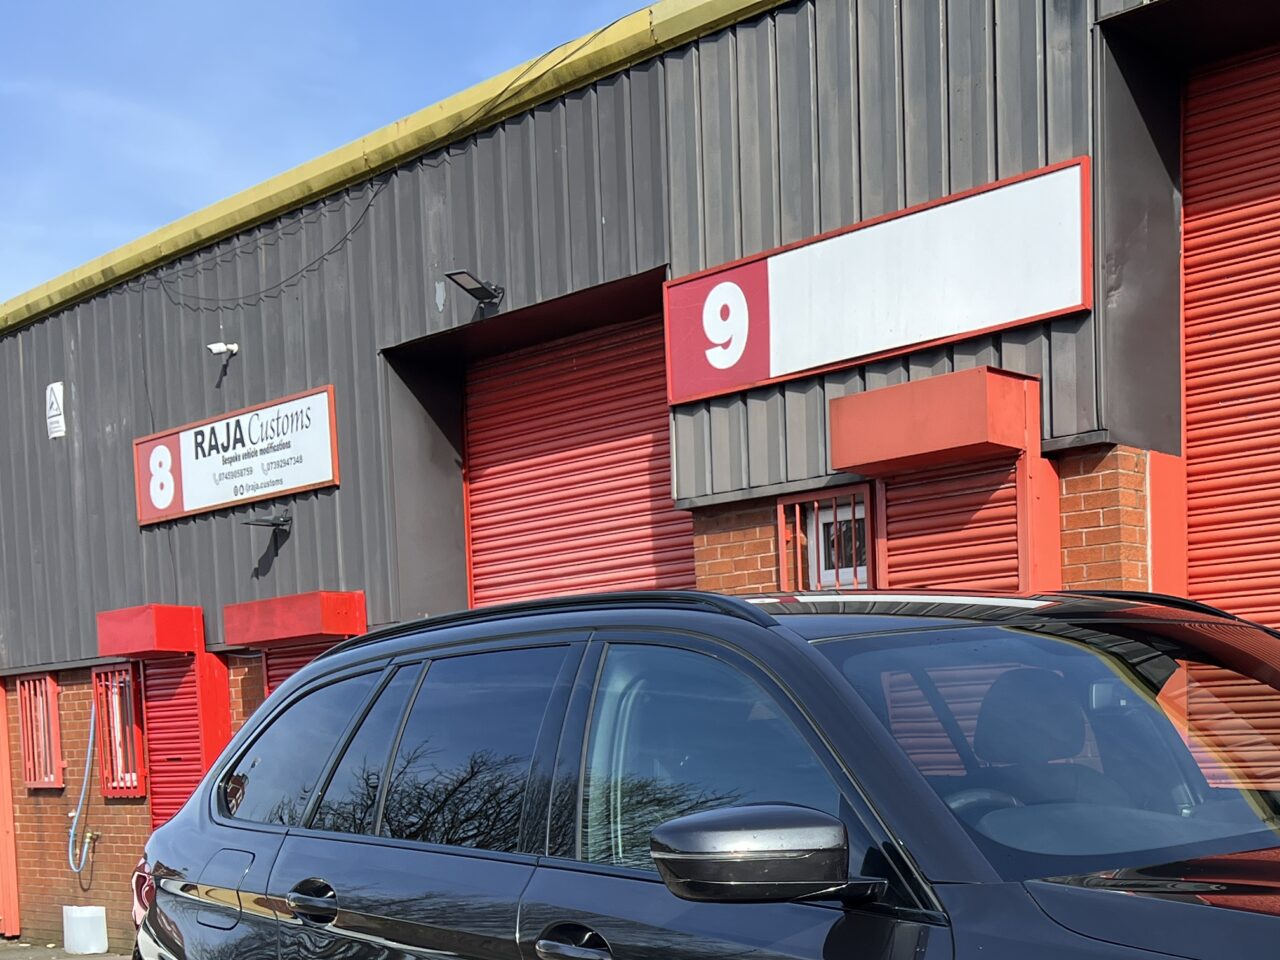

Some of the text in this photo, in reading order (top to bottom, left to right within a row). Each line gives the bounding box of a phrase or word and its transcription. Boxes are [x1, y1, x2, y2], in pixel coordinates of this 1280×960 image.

[702, 281, 749, 369] 9
[194, 406, 311, 460] RAJA Customs
[242, 446, 258, 460] vehicle
[259, 439, 291, 458] modifications
[149, 445, 175, 510] 8
